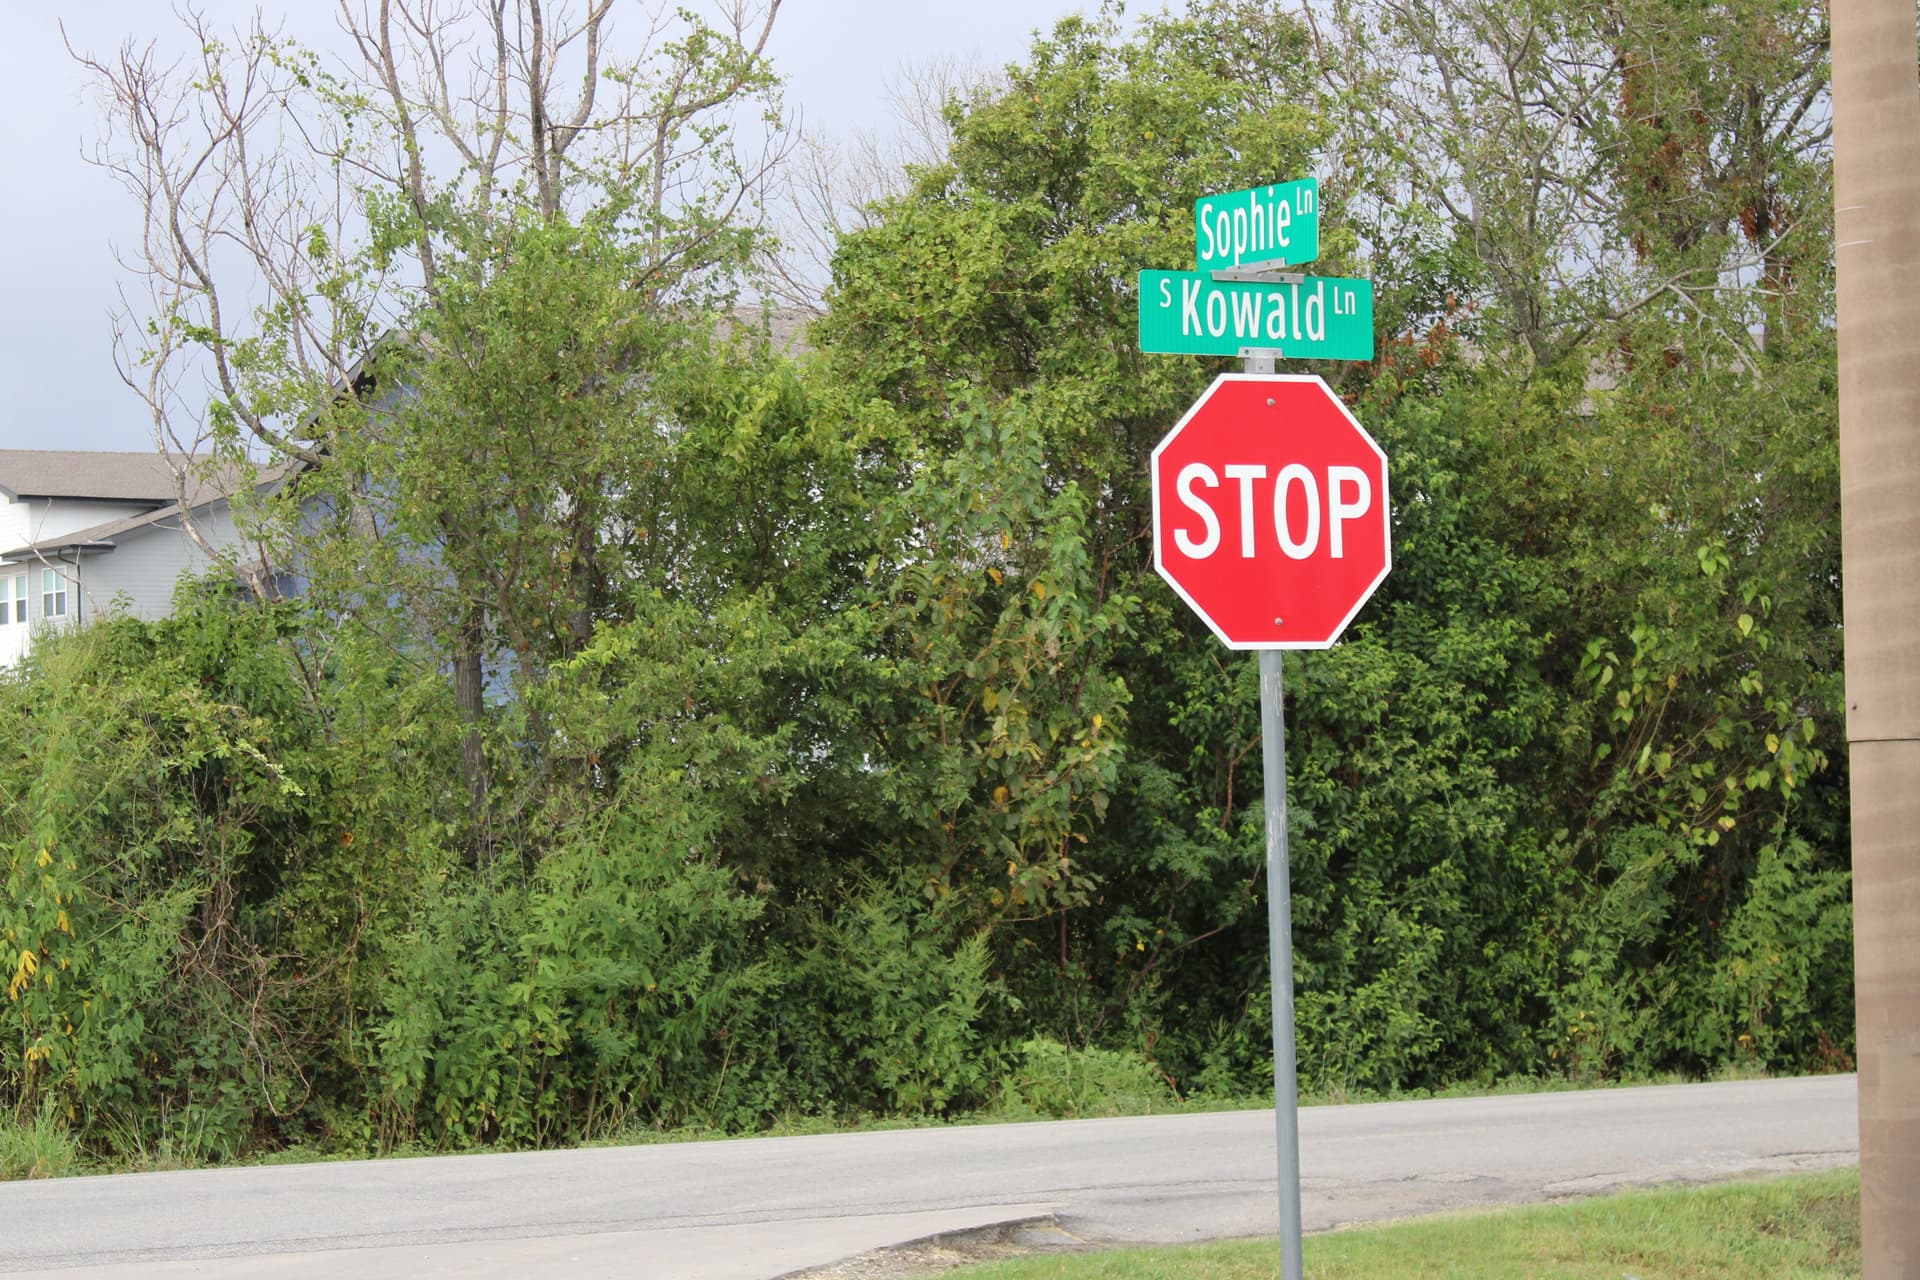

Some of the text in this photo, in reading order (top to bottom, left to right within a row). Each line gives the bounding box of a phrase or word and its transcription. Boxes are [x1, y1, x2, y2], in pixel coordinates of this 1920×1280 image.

[1200, 186, 1314, 268] Sophie Ln
[1159, 278, 1356, 342] S Kowald Ln
[1174, 462, 1371, 560] STOP
